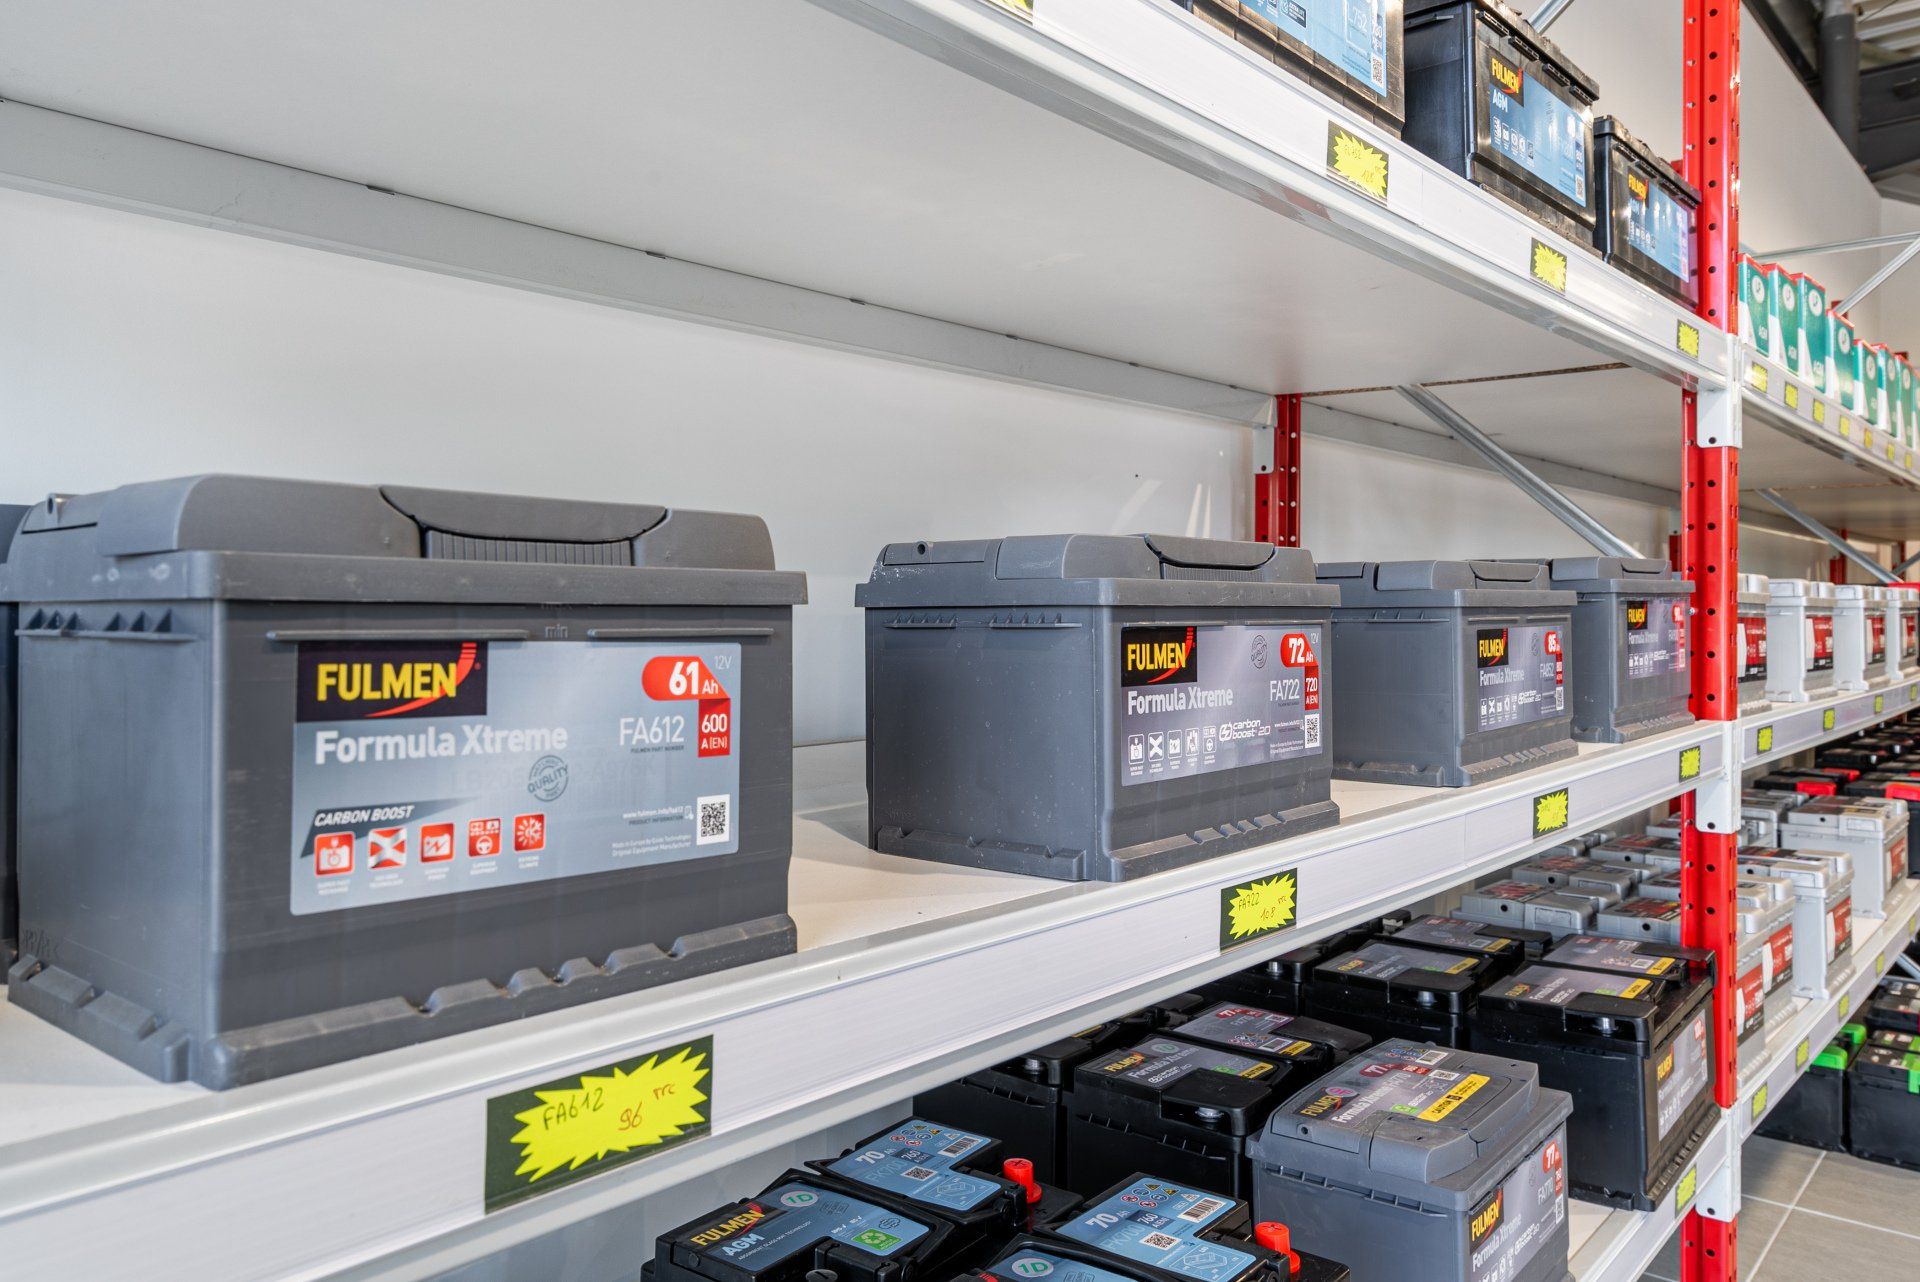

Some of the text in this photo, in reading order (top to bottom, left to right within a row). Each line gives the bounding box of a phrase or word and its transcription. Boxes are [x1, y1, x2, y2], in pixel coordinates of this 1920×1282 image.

[1491, 57, 1519, 94] FULMEN
[1492, 89, 1508, 113] AGM
[1629, 608, 1645, 623] FULMEN
[1289, 637, 1314, 664] 72 Ah
[1480, 639, 1504, 658] FULMEN
[1548, 634, 1556, 653] 85
[713, 655, 732, 670] 12V
[1127, 643, 1186, 671] FULMEN
[317, 662, 457, 702] FULMEN
[668, 661, 719, 696] 61 Ah
[1305, 677, 1318, 692] 720
[1480, 667, 1525, 687] Formula Xtreme
[1127, 686, 1234, 715] Formula Xtreme
[1270, 679, 1300, 702] FA722
[619, 715, 686, 746] FA612
[701, 713, 728, 734] 600
[1232, 728, 1255, 740] boost
[1233, 719, 1261, 730] carbon
[315, 723, 568, 765] Formula Xtreme
[701, 738, 709, 750] A
[527, 764, 569, 793] QUALITY
[314, 805, 415, 827] CARBON BOOST
[1238, 892, 1260, 911] FA722
[1260, 906, 1276, 921] 108
[1104, 1053, 1144, 1073] FULMEN
[1128, 1056, 1168, 1079] Formula
[1364, 1065, 1388, 1075] 77
[542, 1087, 605, 1130] FA612
[618, 1101, 642, 1131] 96
[1331, 1097, 1367, 1123] Formula
[855, 1151, 886, 1164] 70
[1546, 1144, 1556, 1169] 77
[787, 1194, 814, 1204] 1D
[690, 1209, 765, 1247] FULMEN
[1085, 1213, 1119, 1229] 70
[1137, 1213, 1159, 1225] 760
[1472, 1200, 1499, 1242] FULMEN
[722, 1233, 765, 1257] AGM
[1100, 1225, 1146, 1251] FK700
[1472, 1236, 1500, 1273] Formula
[1018, 1261, 1050, 1274] 1D
